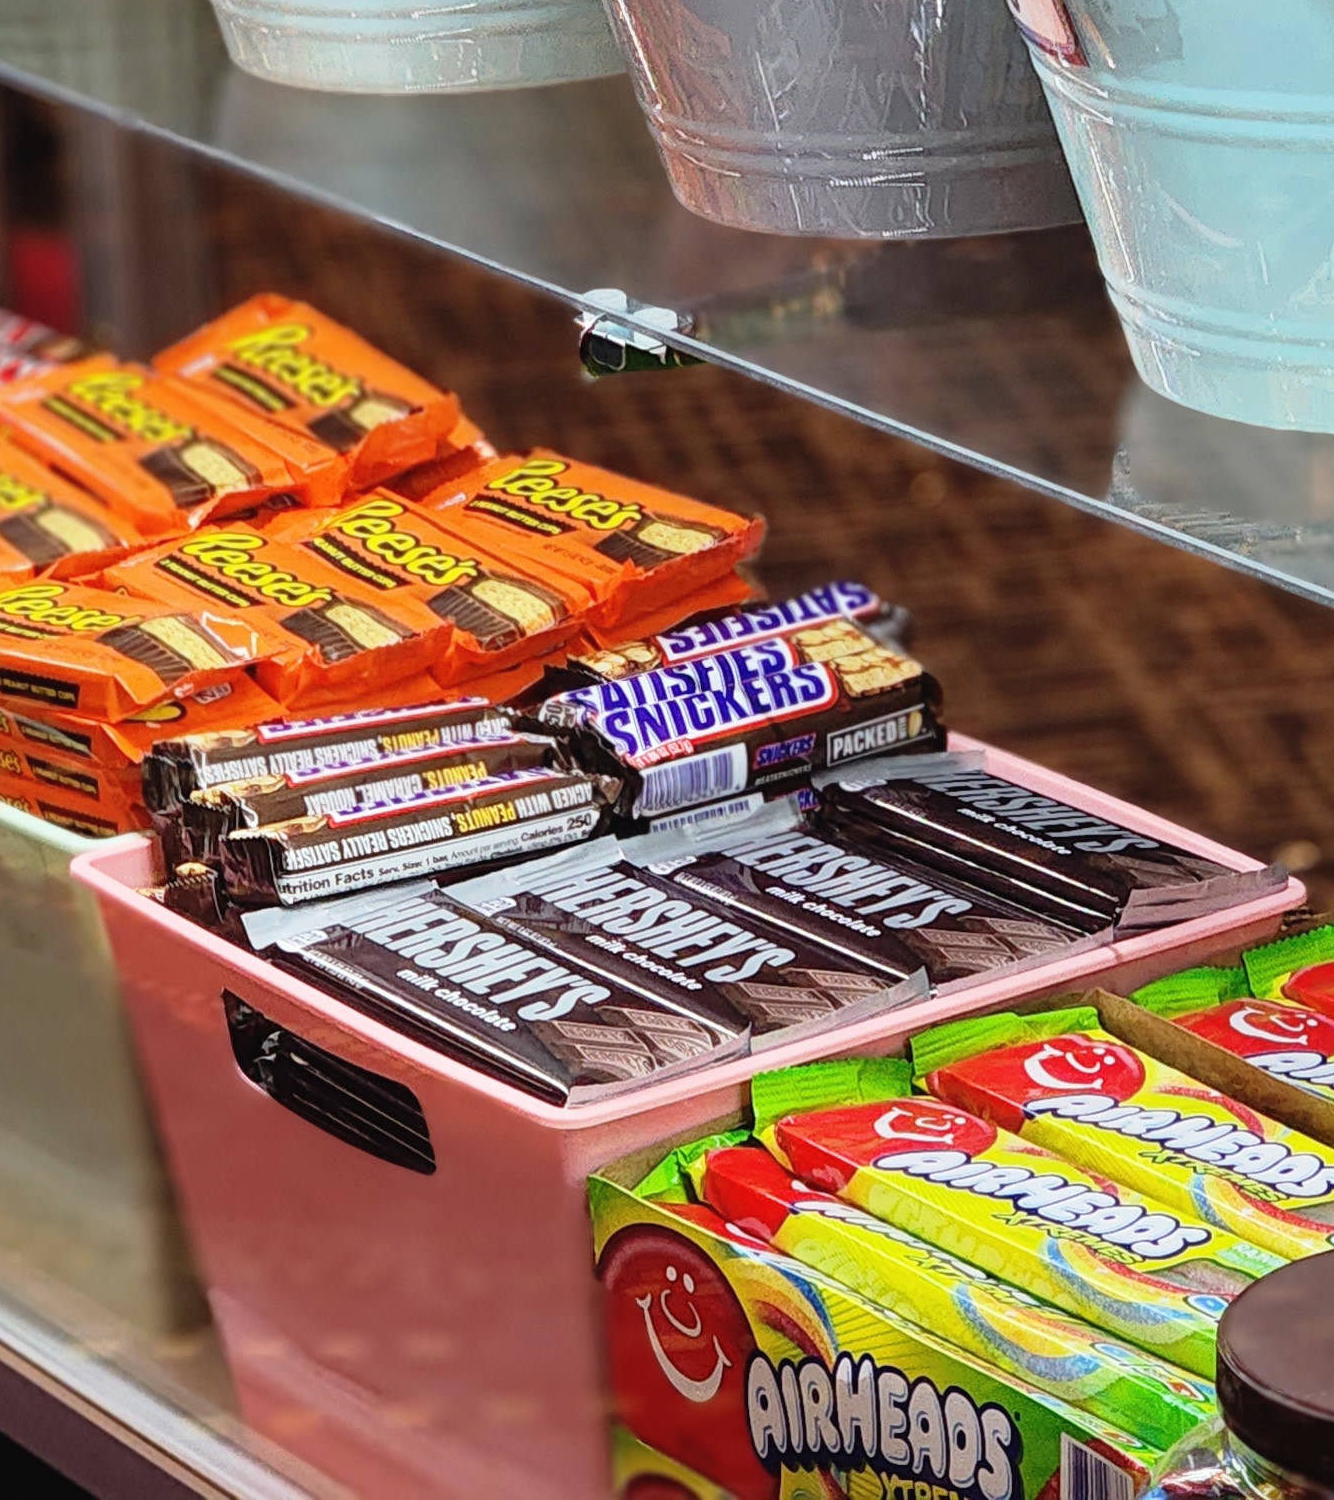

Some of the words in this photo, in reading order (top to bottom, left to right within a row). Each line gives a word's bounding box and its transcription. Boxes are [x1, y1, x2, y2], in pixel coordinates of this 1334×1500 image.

[487, 457, 643, 531] Reese's
[181, 532, 333, 608] Reese's
[319, 498, 479, 586] Reese's
[602, 663, 830, 757] SNICKERS
[833, 720, 898, 761] PACKED
[515, 790, 553, 819] WITH
[551, 782, 594, 810] ACKED
[278, 873, 330, 897] utrition
[334, 867, 376, 887] Facts
[521, 825, 565, 843] Calories
[566, 812, 593, 831] 250
[341, 830, 389, 860] REALLY
[387, 817, 454, 851] SNICKERS
[721, 831, 973, 930] HERSHEY'S
[765, 884, 806, 907] milk
[801, 898, 884, 940] chocolate
[349, 894, 611, 1022] HERSHEY'S
[533, 866, 796, 983] HERSHEY'S
[584, 933, 621, 956] milk
[620, 950, 704, 992] chocolate
[395, 967, 437, 993] milk
[433, 985, 517, 1033] chocolate
[873, 1148, 1213, 1259] AIRHEADS
[992, 1210, 1145, 1267] XTREMES
[747, 1354, 1013, 1491] AIRHEADS
